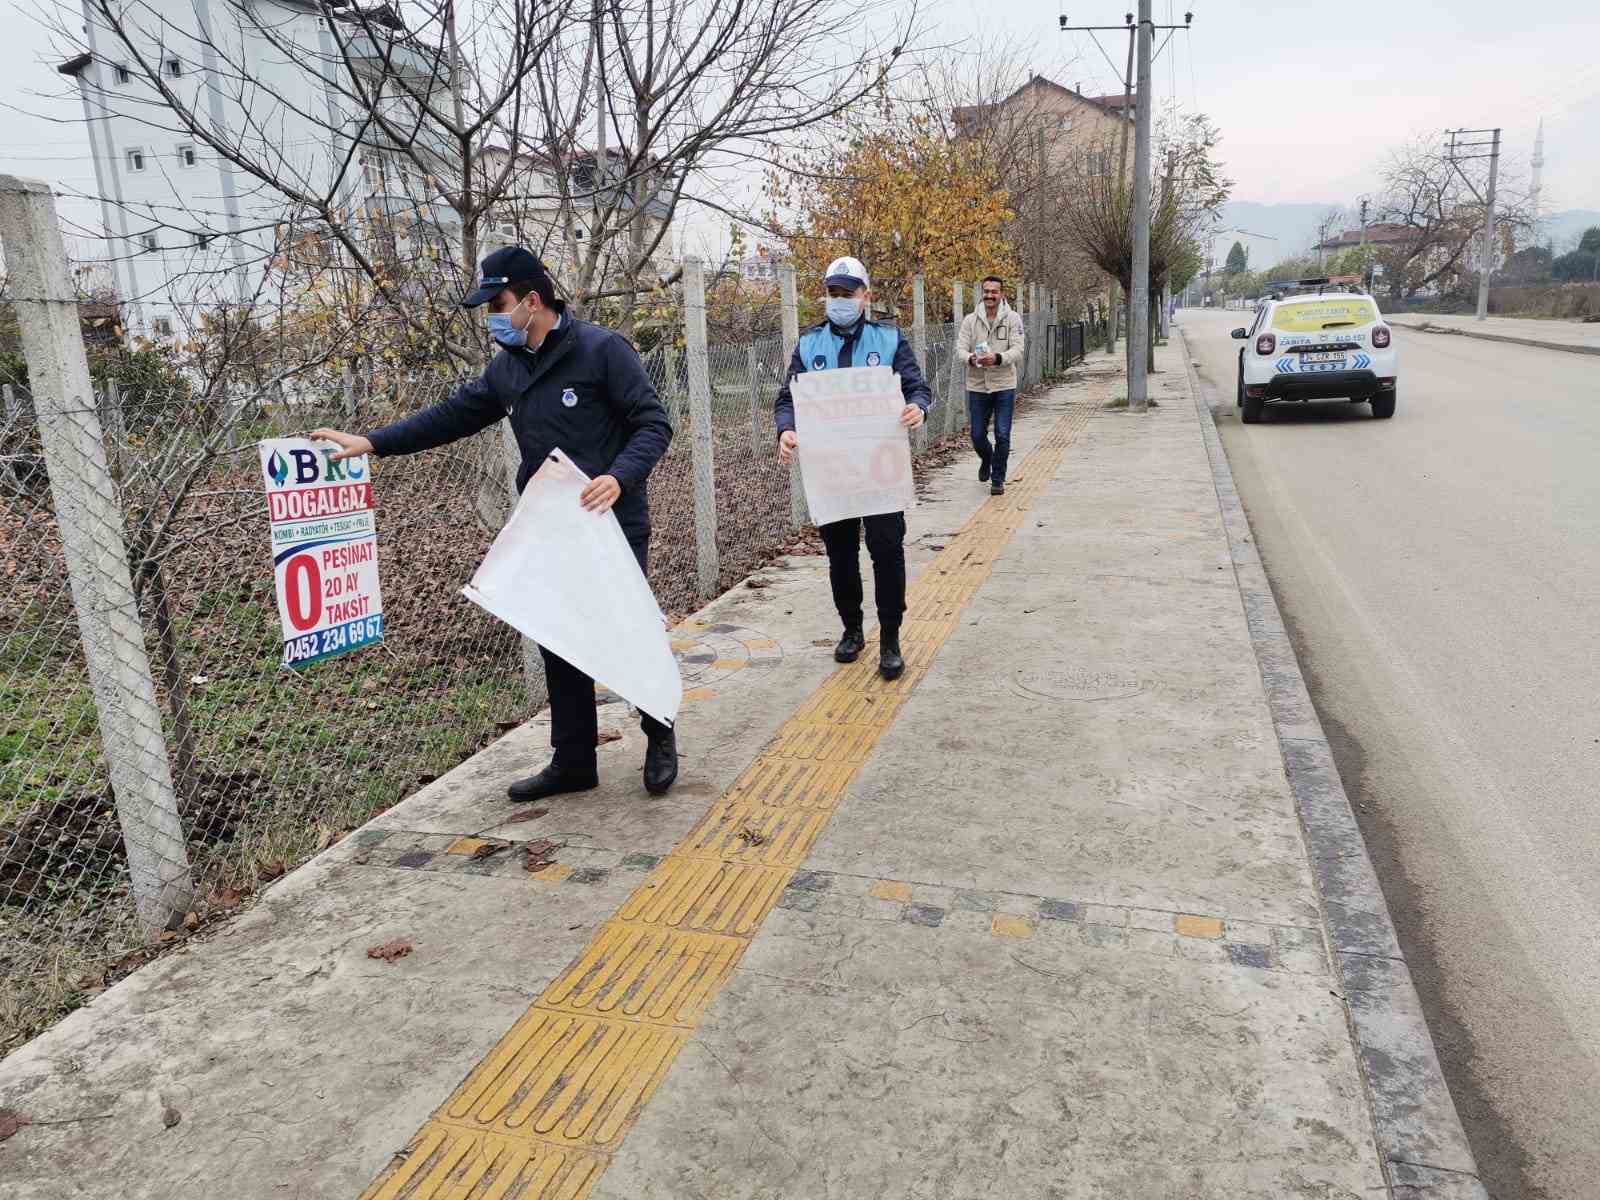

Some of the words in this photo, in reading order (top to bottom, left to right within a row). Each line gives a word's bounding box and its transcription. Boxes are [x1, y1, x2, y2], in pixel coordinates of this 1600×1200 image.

[289, 448, 364, 484] BRC
[271, 485, 367, 520] DOĞALGAZ
[323, 542, 373, 572] PEŞİNAT
[286, 554, 322, 631] 0
[325, 577, 342, 598] 20
[346, 572, 359, 593] AY
[326, 593, 369, 625] TAKSİT
[285, 634, 319, 663] 0452
[322, 626, 346, 653] 234
[349, 621, 365, 644] 69
[366, 615, 381, 638] 67
